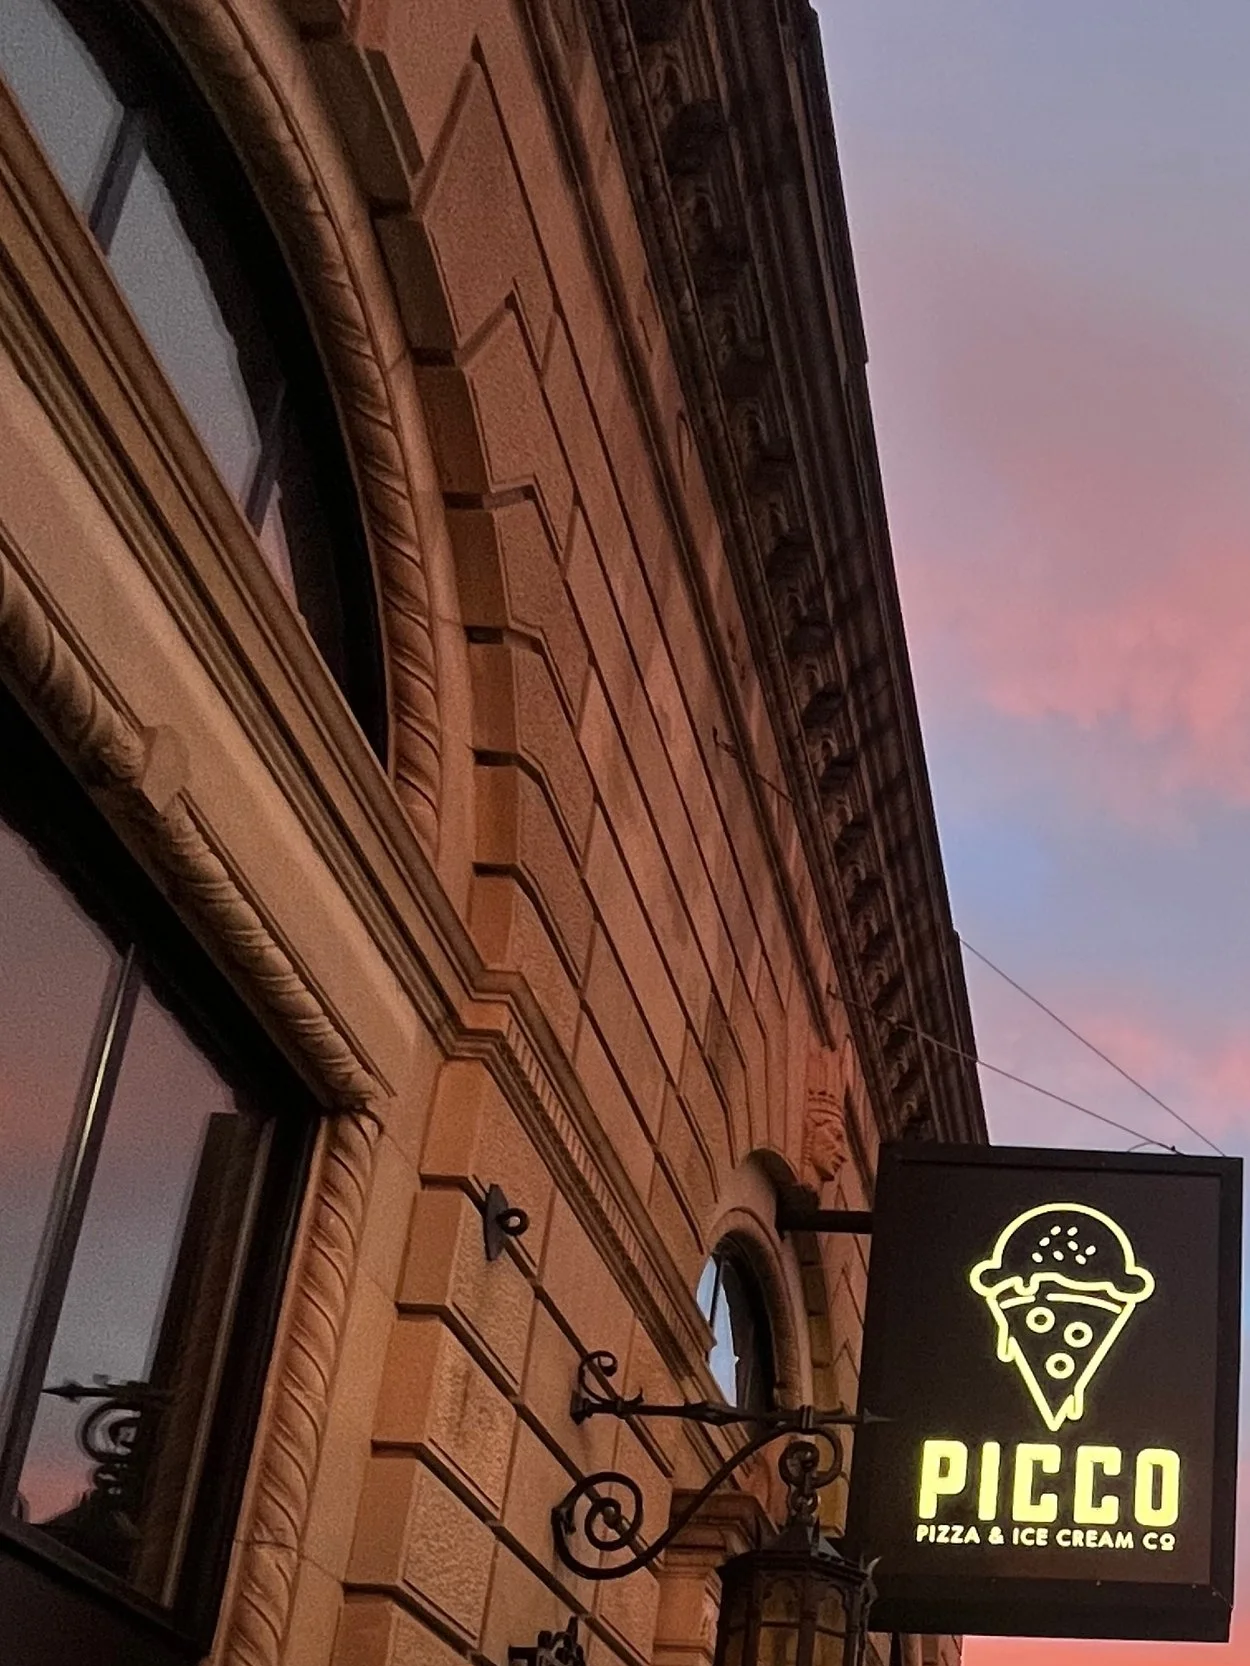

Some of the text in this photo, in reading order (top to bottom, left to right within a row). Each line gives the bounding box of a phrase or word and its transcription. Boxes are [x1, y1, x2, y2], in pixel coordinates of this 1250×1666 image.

[918, 1440, 1181, 1527] PICCO
[916, 1525, 981, 1545] PIZZA
[988, 1526, 1005, 1545] &
[1012, 1528, 1049, 1546] ICE
[1056, 1529, 1134, 1549] CREAM
